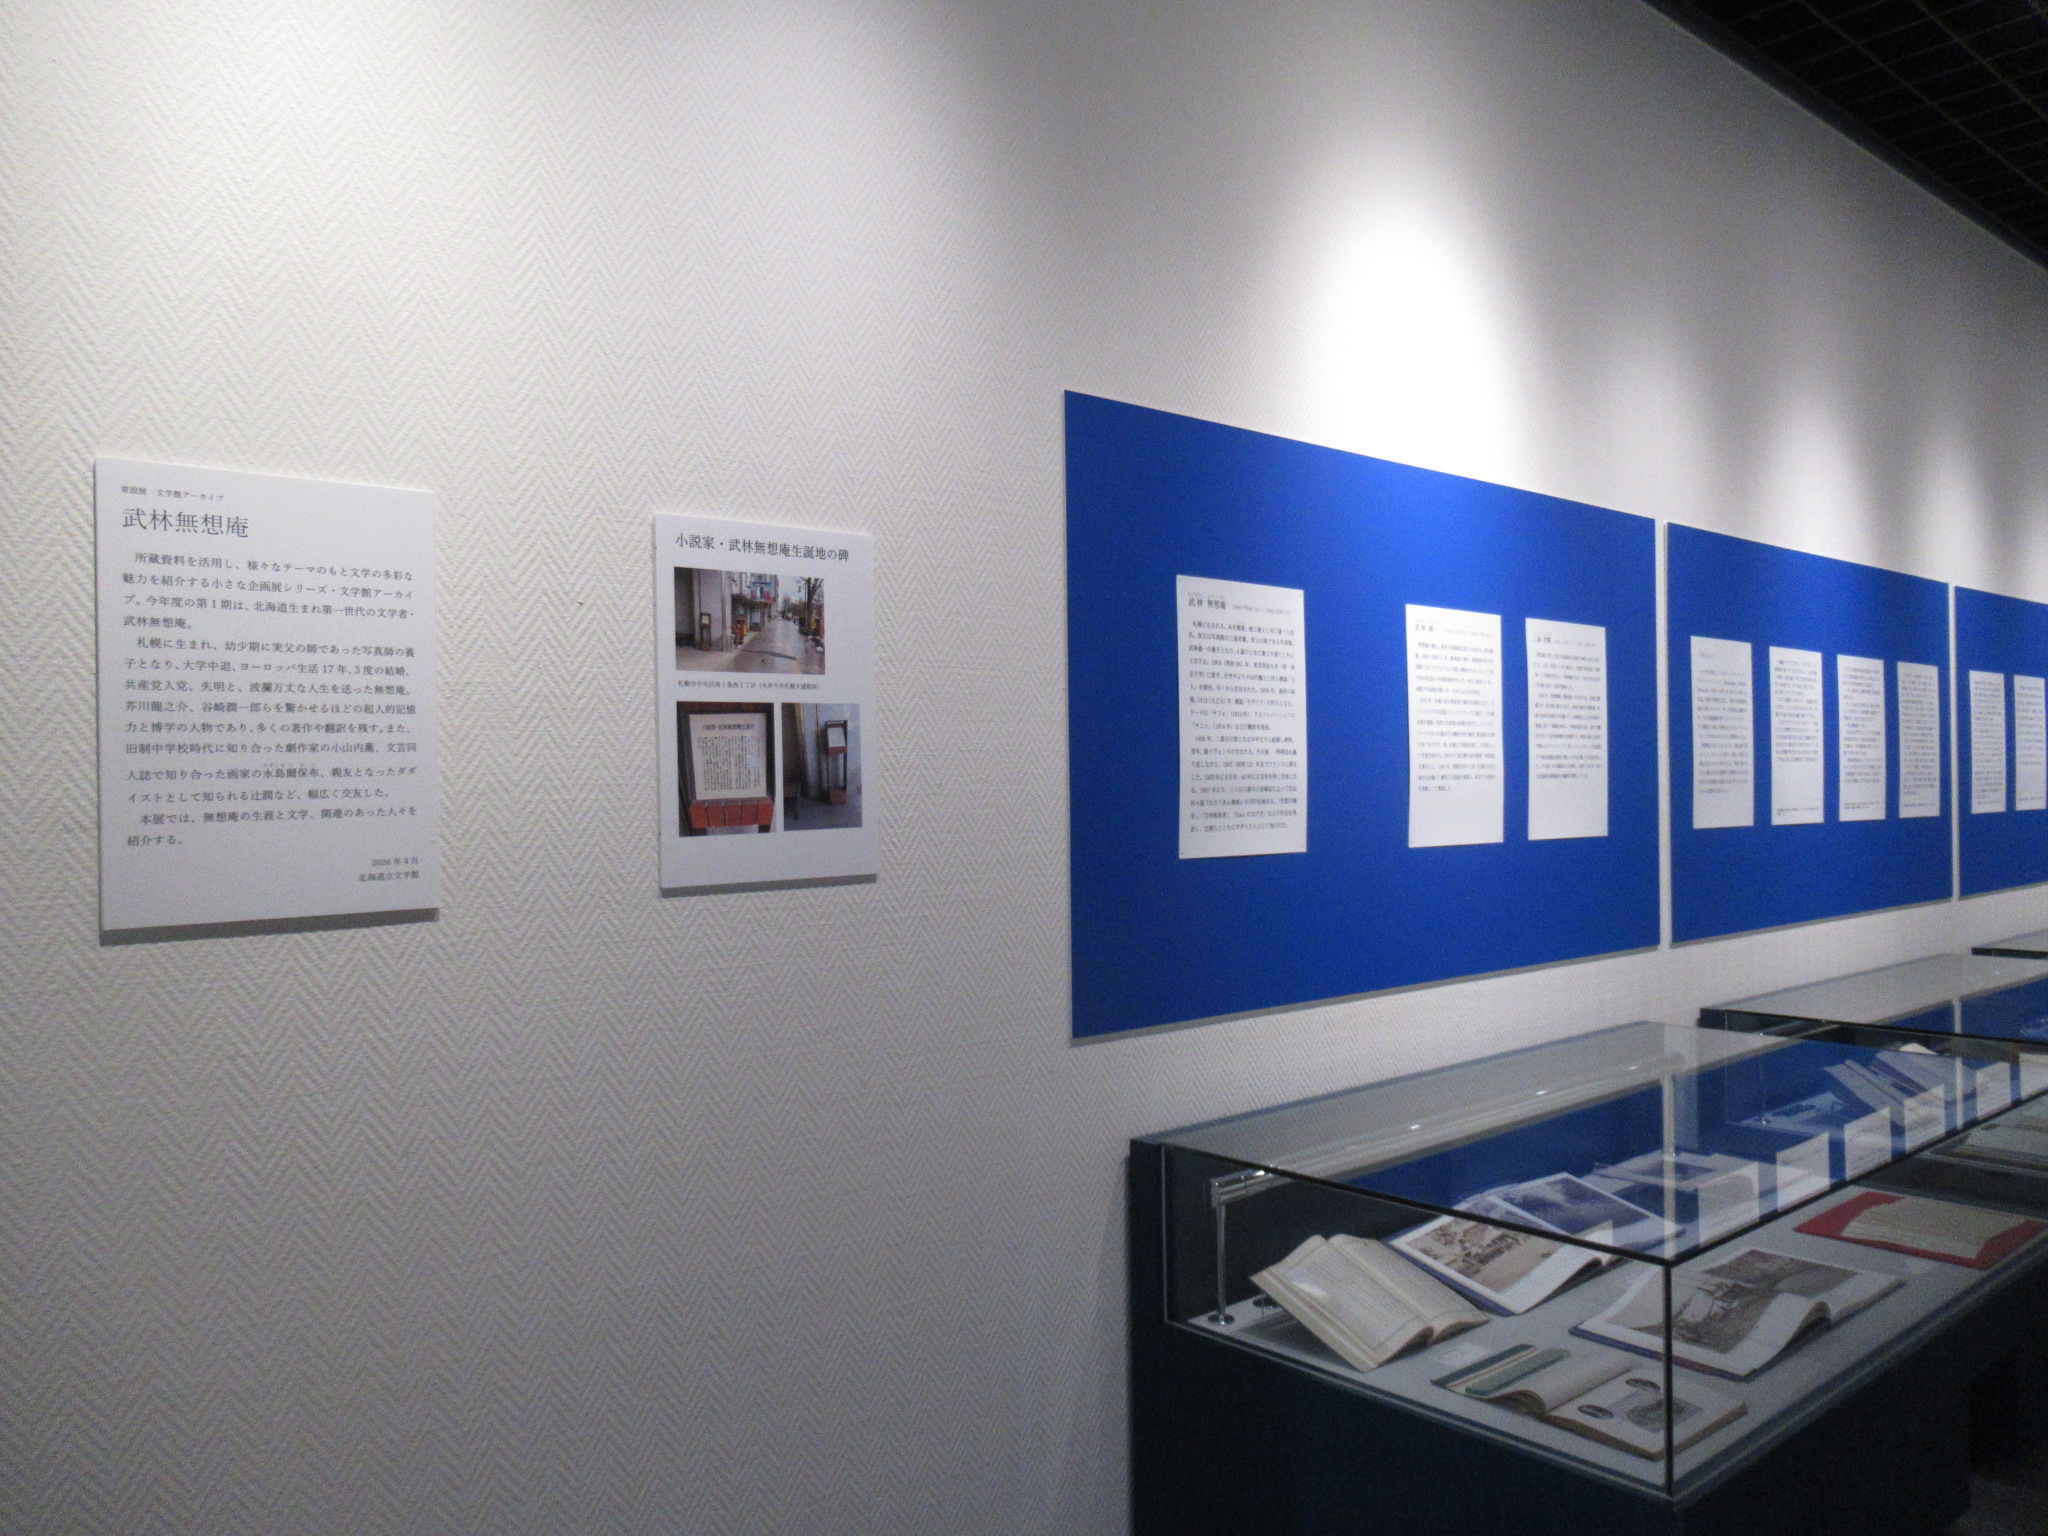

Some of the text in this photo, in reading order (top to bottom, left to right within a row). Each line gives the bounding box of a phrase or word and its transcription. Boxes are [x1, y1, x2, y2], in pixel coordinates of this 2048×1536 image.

[122, 508, 249, 538] 武林無想庵
[676, 533, 849, 562] 小説家・武林無想庵生誕地の碑
[135, 552, 413, 581] 所蔵資料を活用し、様々なテーマのもと文学の多彩な
[123, 573, 413, 599] 魅力を紹介する小さな企画展シリーズ・文学館アーカイ
[124, 616, 192, 630] 武林無想庵。
[137, 638, 415, 658] 札幌に生まれ、幼少期に実父の師であった写真師の養
[127, 835, 184, 847] 紹介する。
